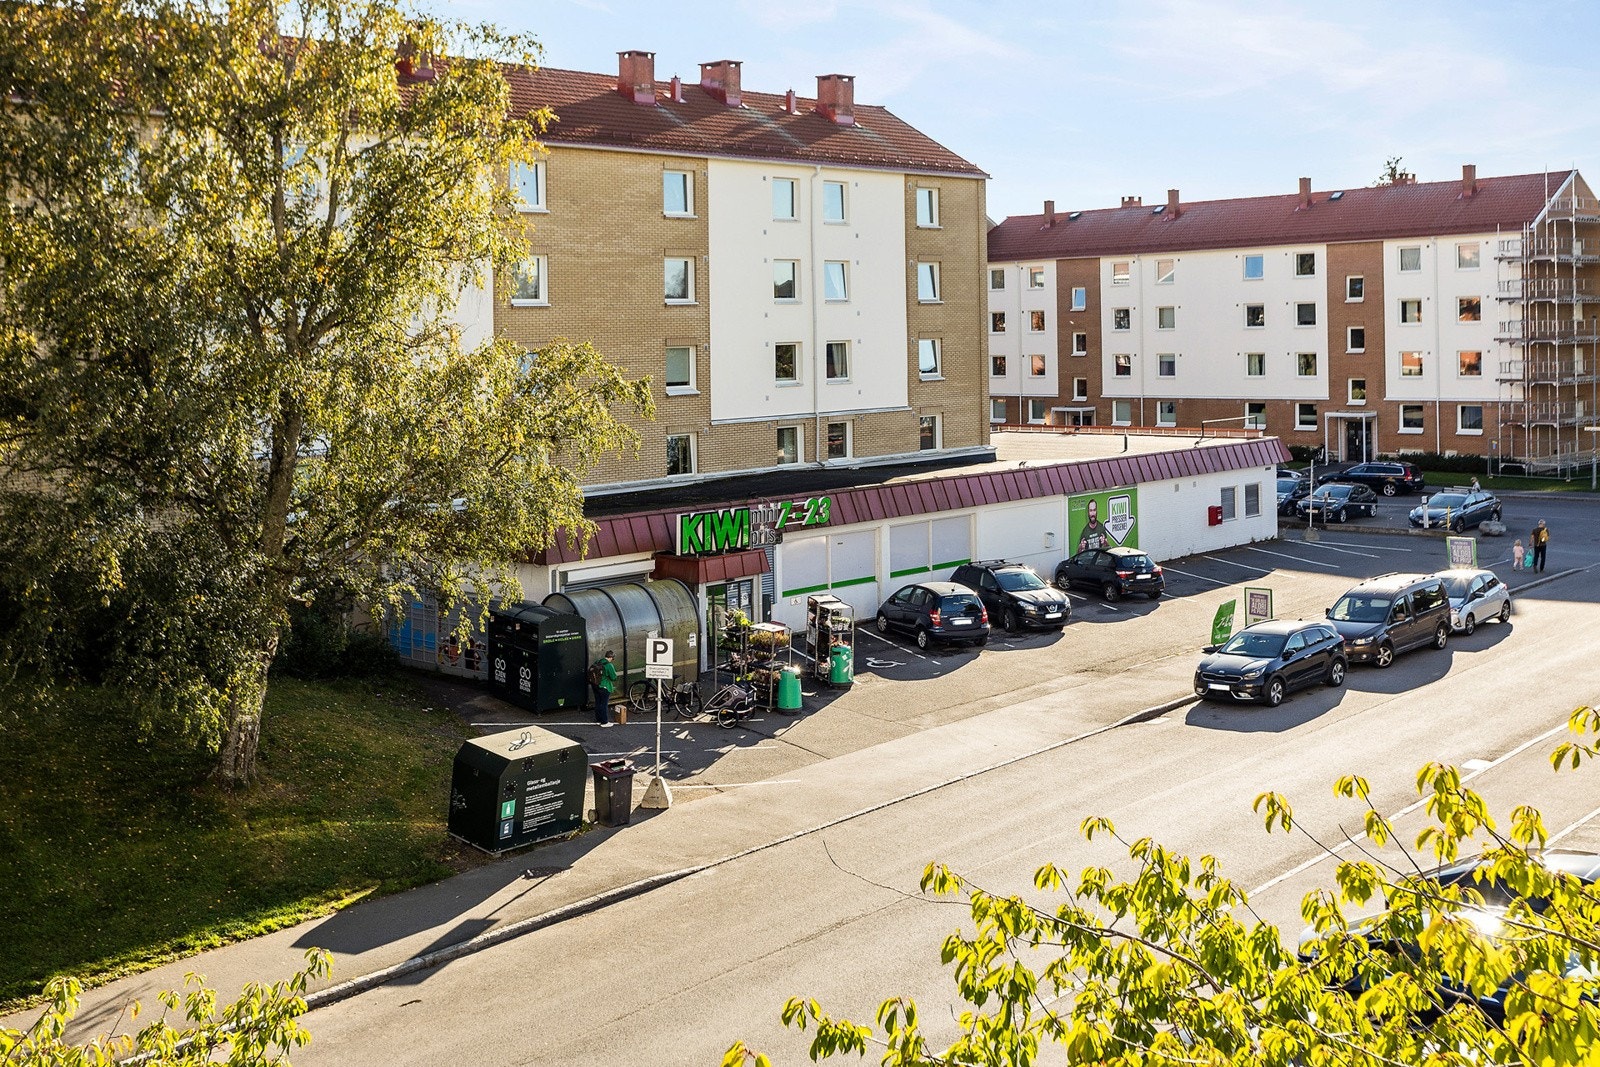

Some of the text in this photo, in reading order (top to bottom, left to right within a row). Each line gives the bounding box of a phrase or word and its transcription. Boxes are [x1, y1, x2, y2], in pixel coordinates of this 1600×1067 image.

[751, 504, 778, 525] mini
[776, 497, 832, 529] 7-23
[1111, 502, 1127, 515] KIWI
[1111, 514, 1127, 523] PRESSER
[678, 508, 750, 555] KIWI
[751, 524, 776, 549] pris
[653, 641, 668, 663] P
[495, 658, 506, 671] GO
[520, 666, 531, 680] GO
